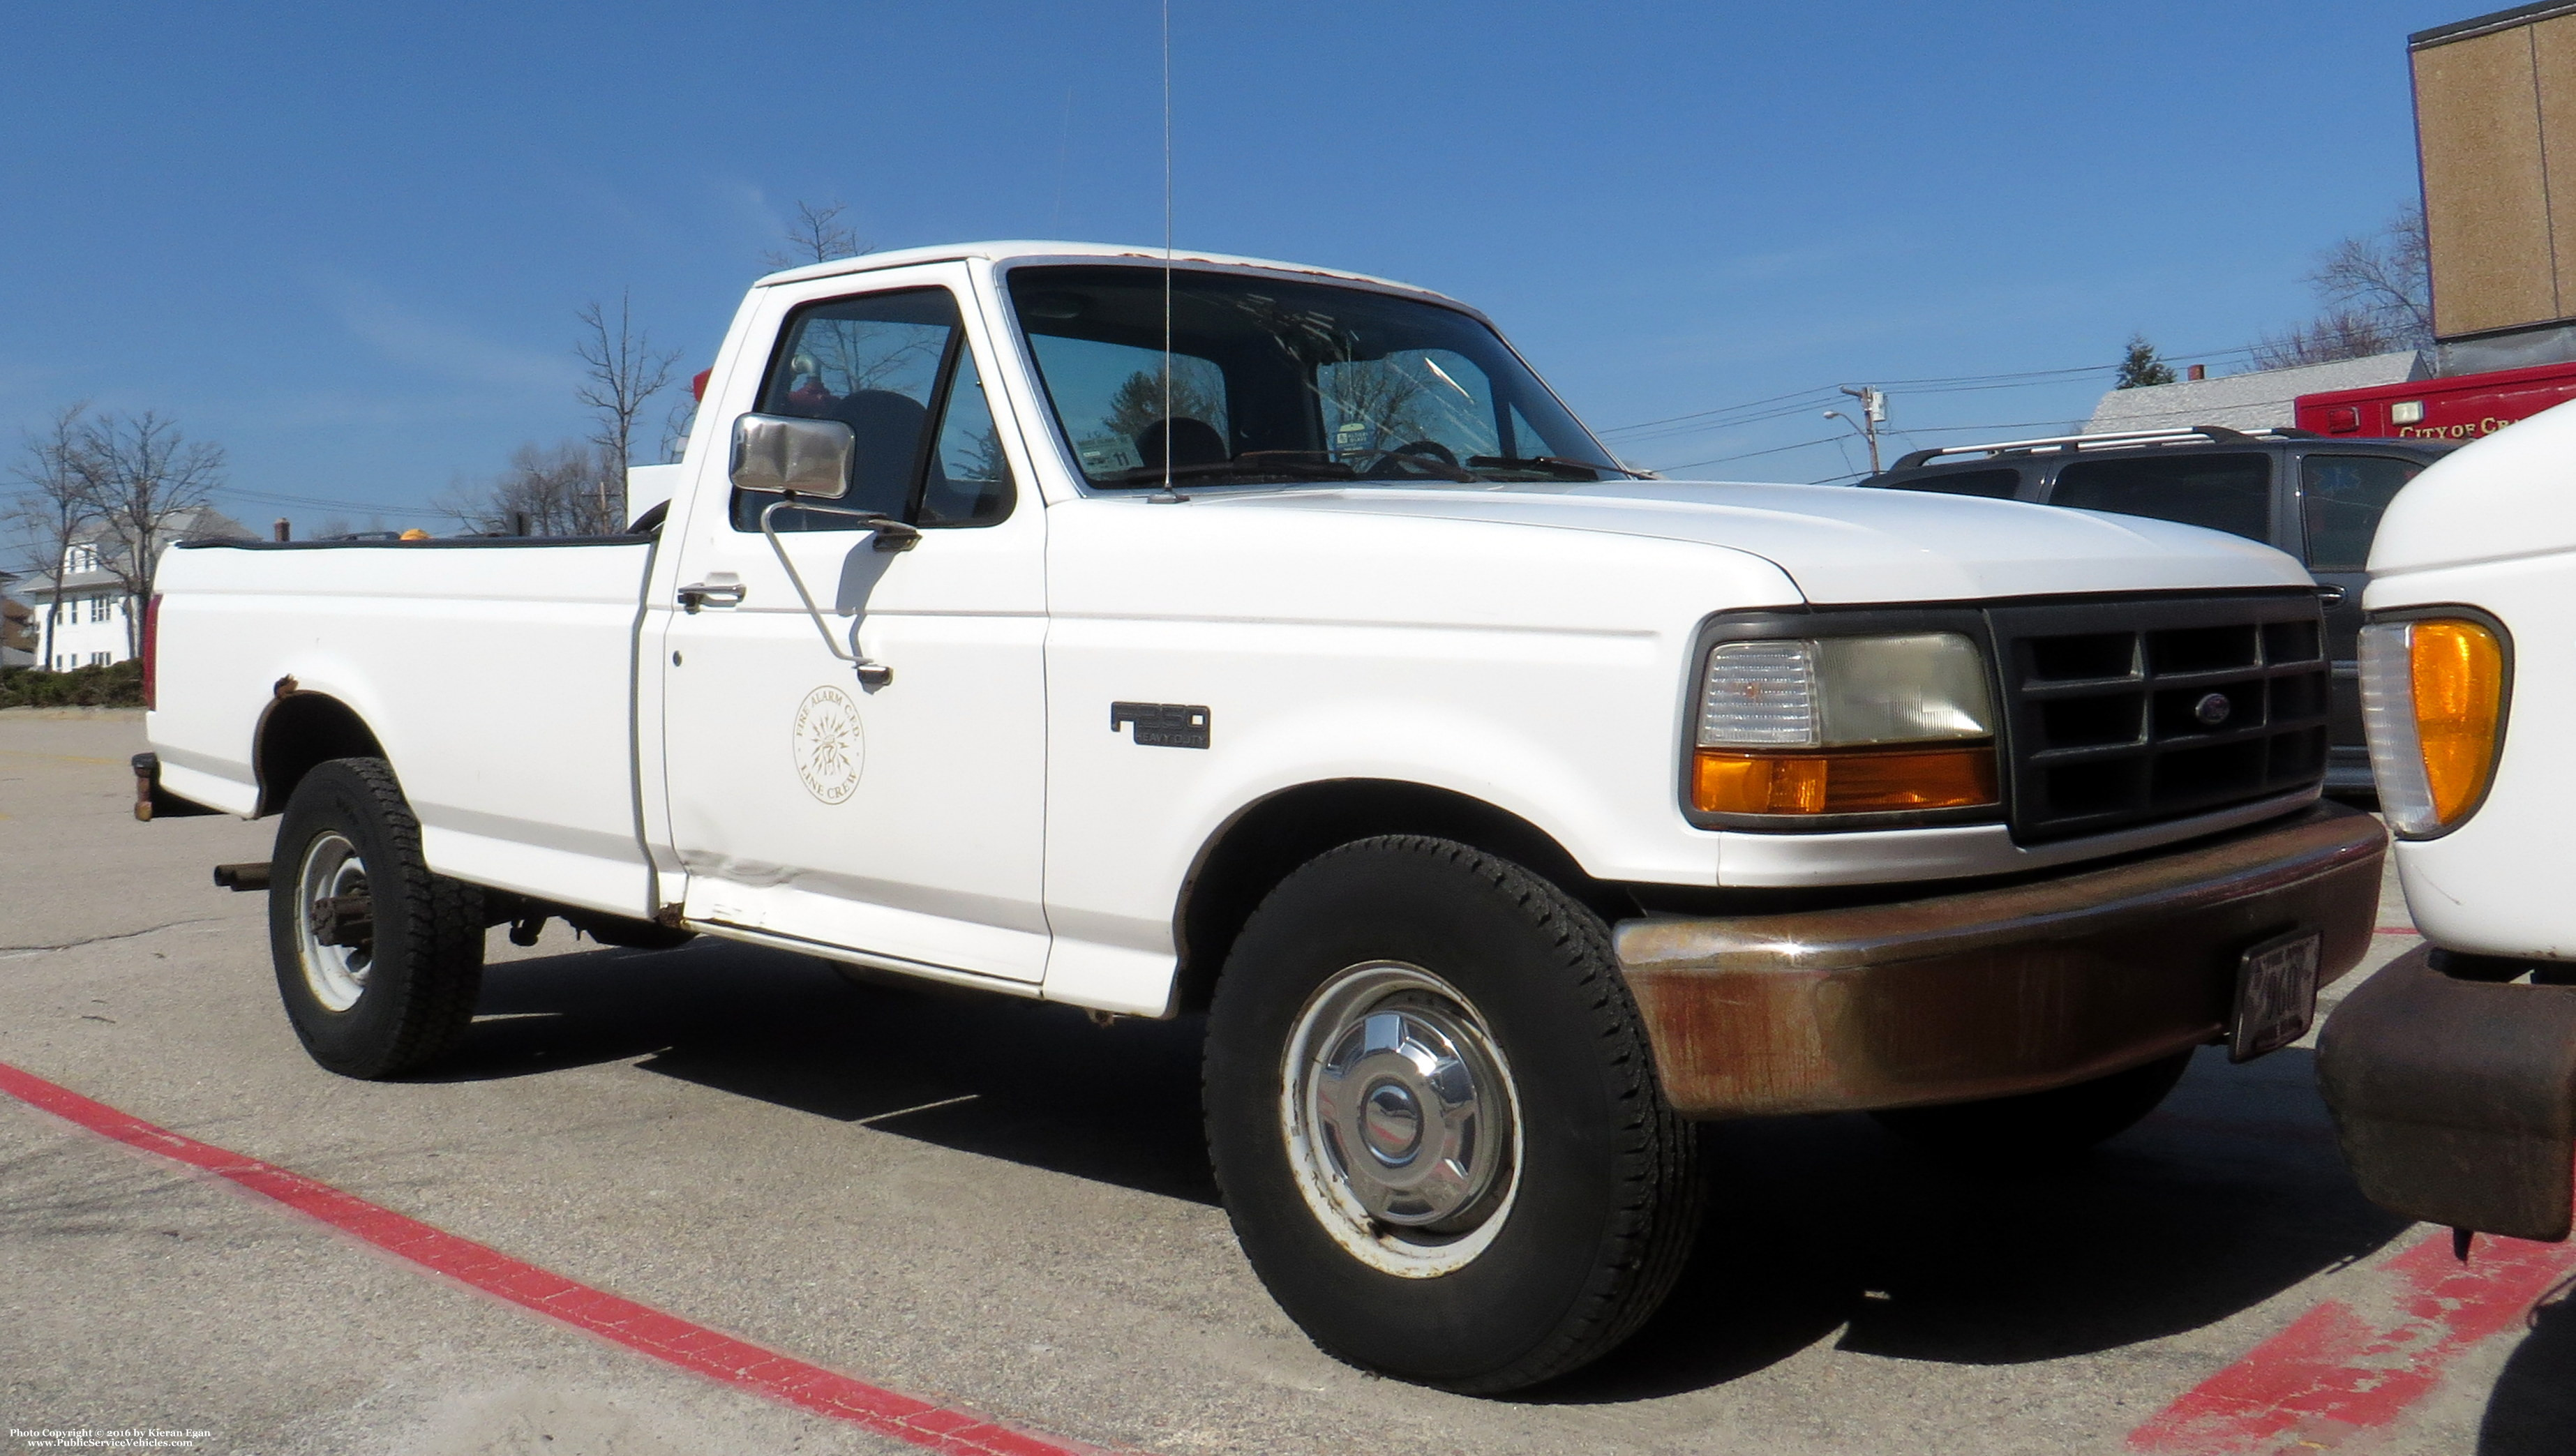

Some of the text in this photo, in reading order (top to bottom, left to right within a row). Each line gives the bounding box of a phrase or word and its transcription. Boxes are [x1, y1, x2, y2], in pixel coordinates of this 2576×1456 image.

[2399, 426, 2448, 438] CITY
[796, 705, 809, 736] FIRE
[811, 691, 842, 707] ALARM
[801, 765, 857, 799] LINE CREW
